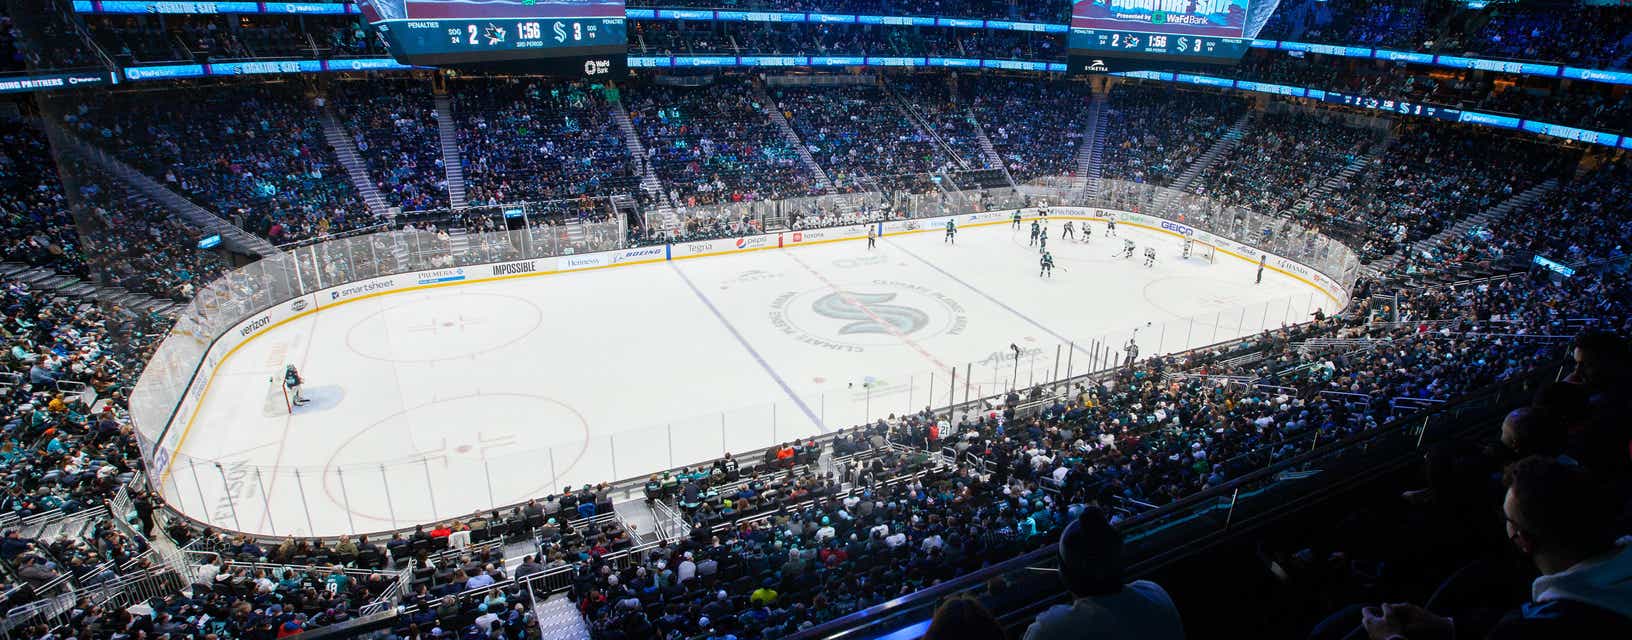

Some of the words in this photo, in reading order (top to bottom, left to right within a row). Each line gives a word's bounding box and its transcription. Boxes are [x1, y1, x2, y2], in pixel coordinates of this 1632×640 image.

[1195, 0, 1232, 15] SAVE
[1167, 14, 1189, 23] WaFd
[468, 24, 479, 45] 2
[517, 22, 541, 40] 1:56
[573, 22, 581, 40] 3
[451, 36, 460, 44] 24
[1111, 34, 1120, 46] 2
[1148, 35, 1167, 48] 1:56
[1193, 38, 1202, 52] 3
[21, 78, 63, 88] PARTNERS
[1161, 220, 1193, 236] GEICO
[747, 235, 768, 245] pepsi
[625, 248, 662, 258] BOEING
[418, 270, 453, 279] PREMERA
[493, 261, 536, 276] IMPOSSIBLE
[341, 279, 395, 296] smartsheet
[239, 315, 270, 337] verizon
[326, 582, 337, 593] 18
